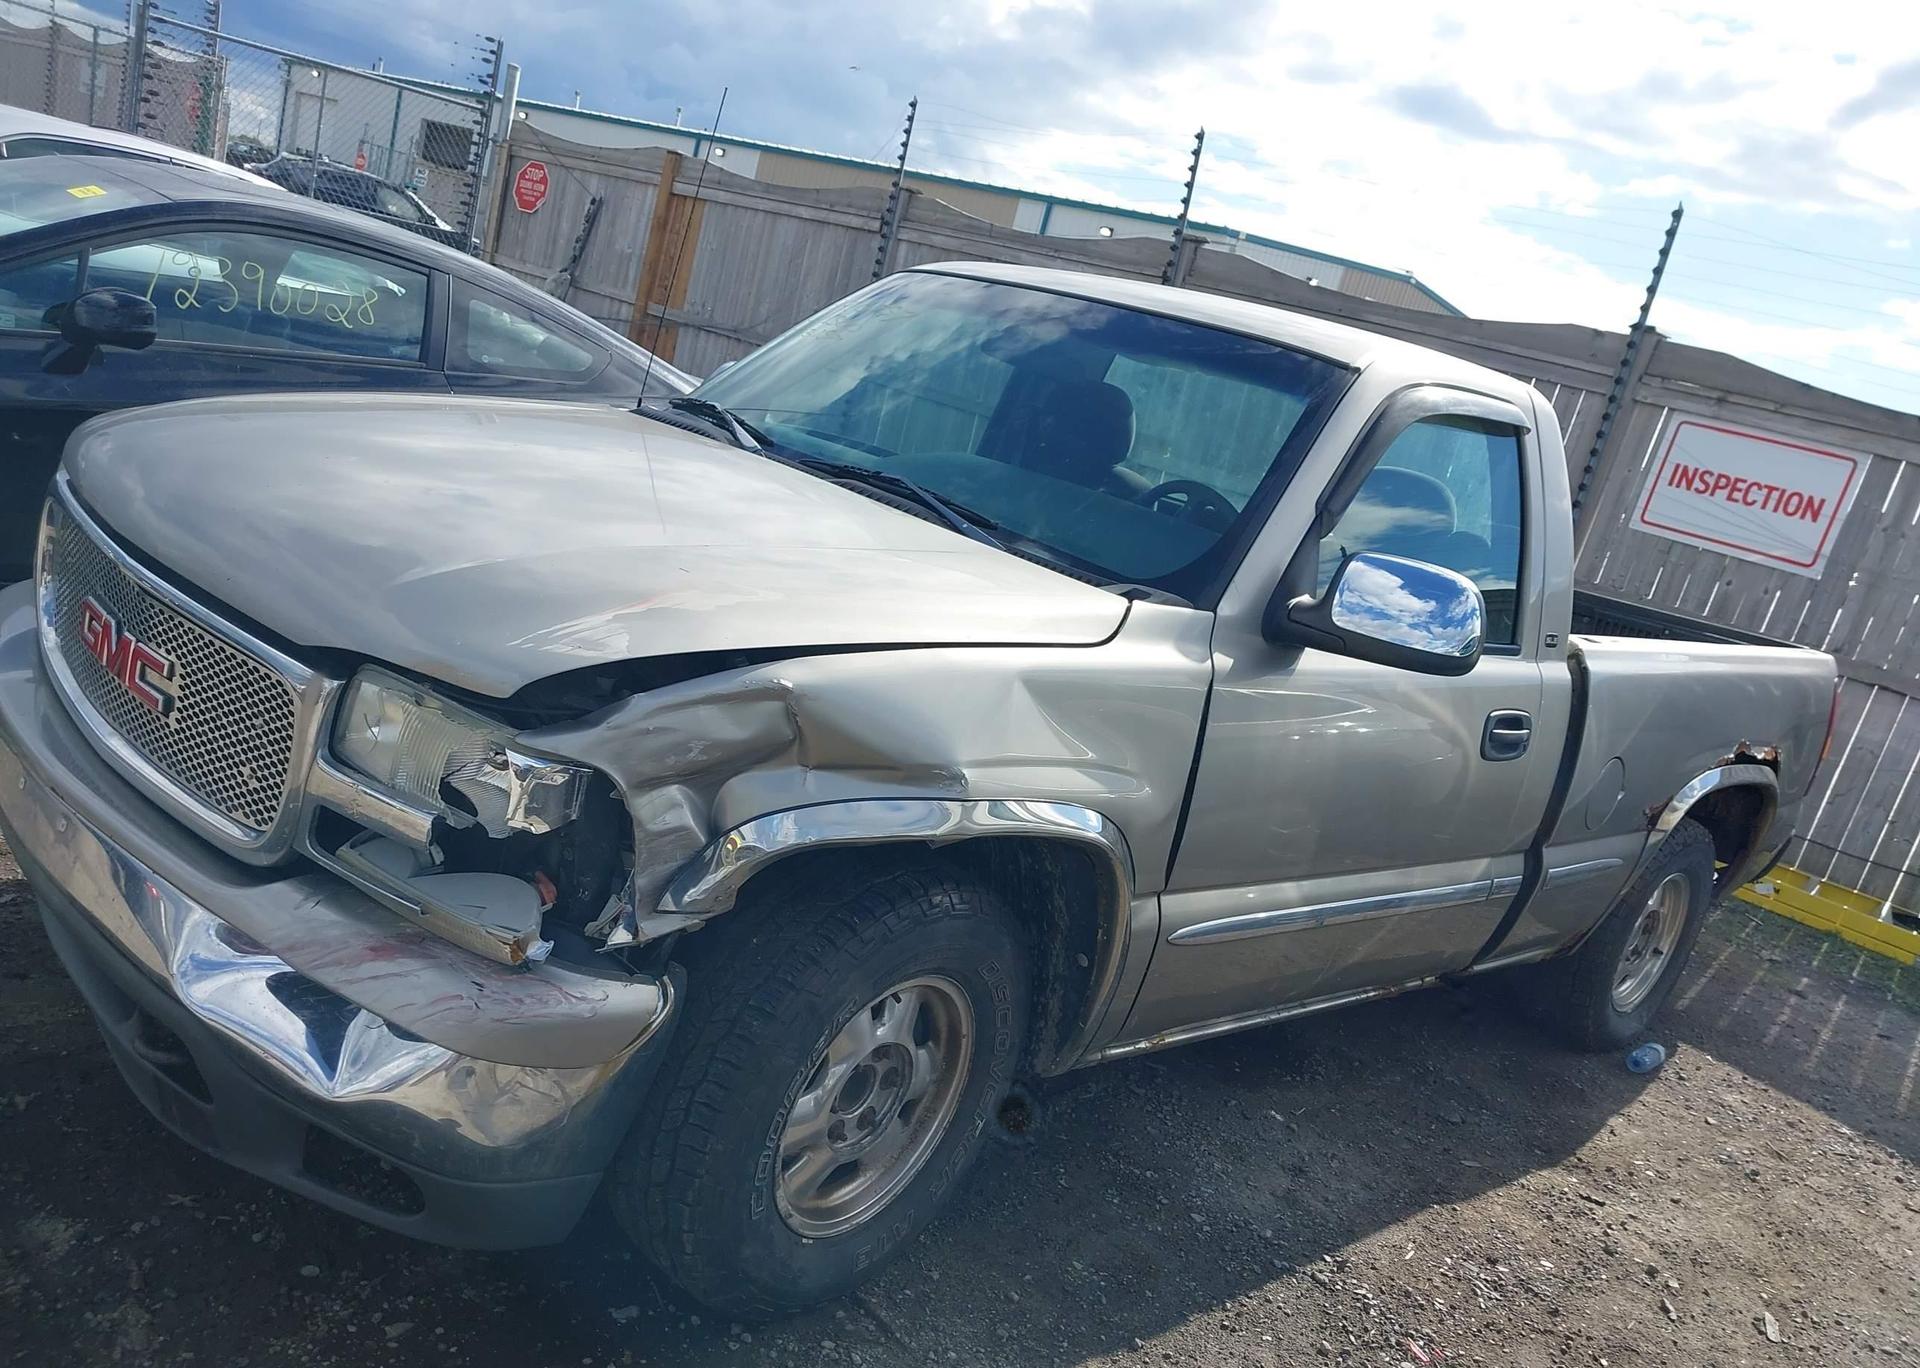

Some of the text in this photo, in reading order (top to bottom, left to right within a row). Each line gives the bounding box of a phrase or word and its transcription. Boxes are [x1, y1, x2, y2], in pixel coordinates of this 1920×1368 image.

[525, 167, 545, 181] STOP
[1667, 463, 1826, 523] INSPECTION
[80, 595, 168, 715] GMC
